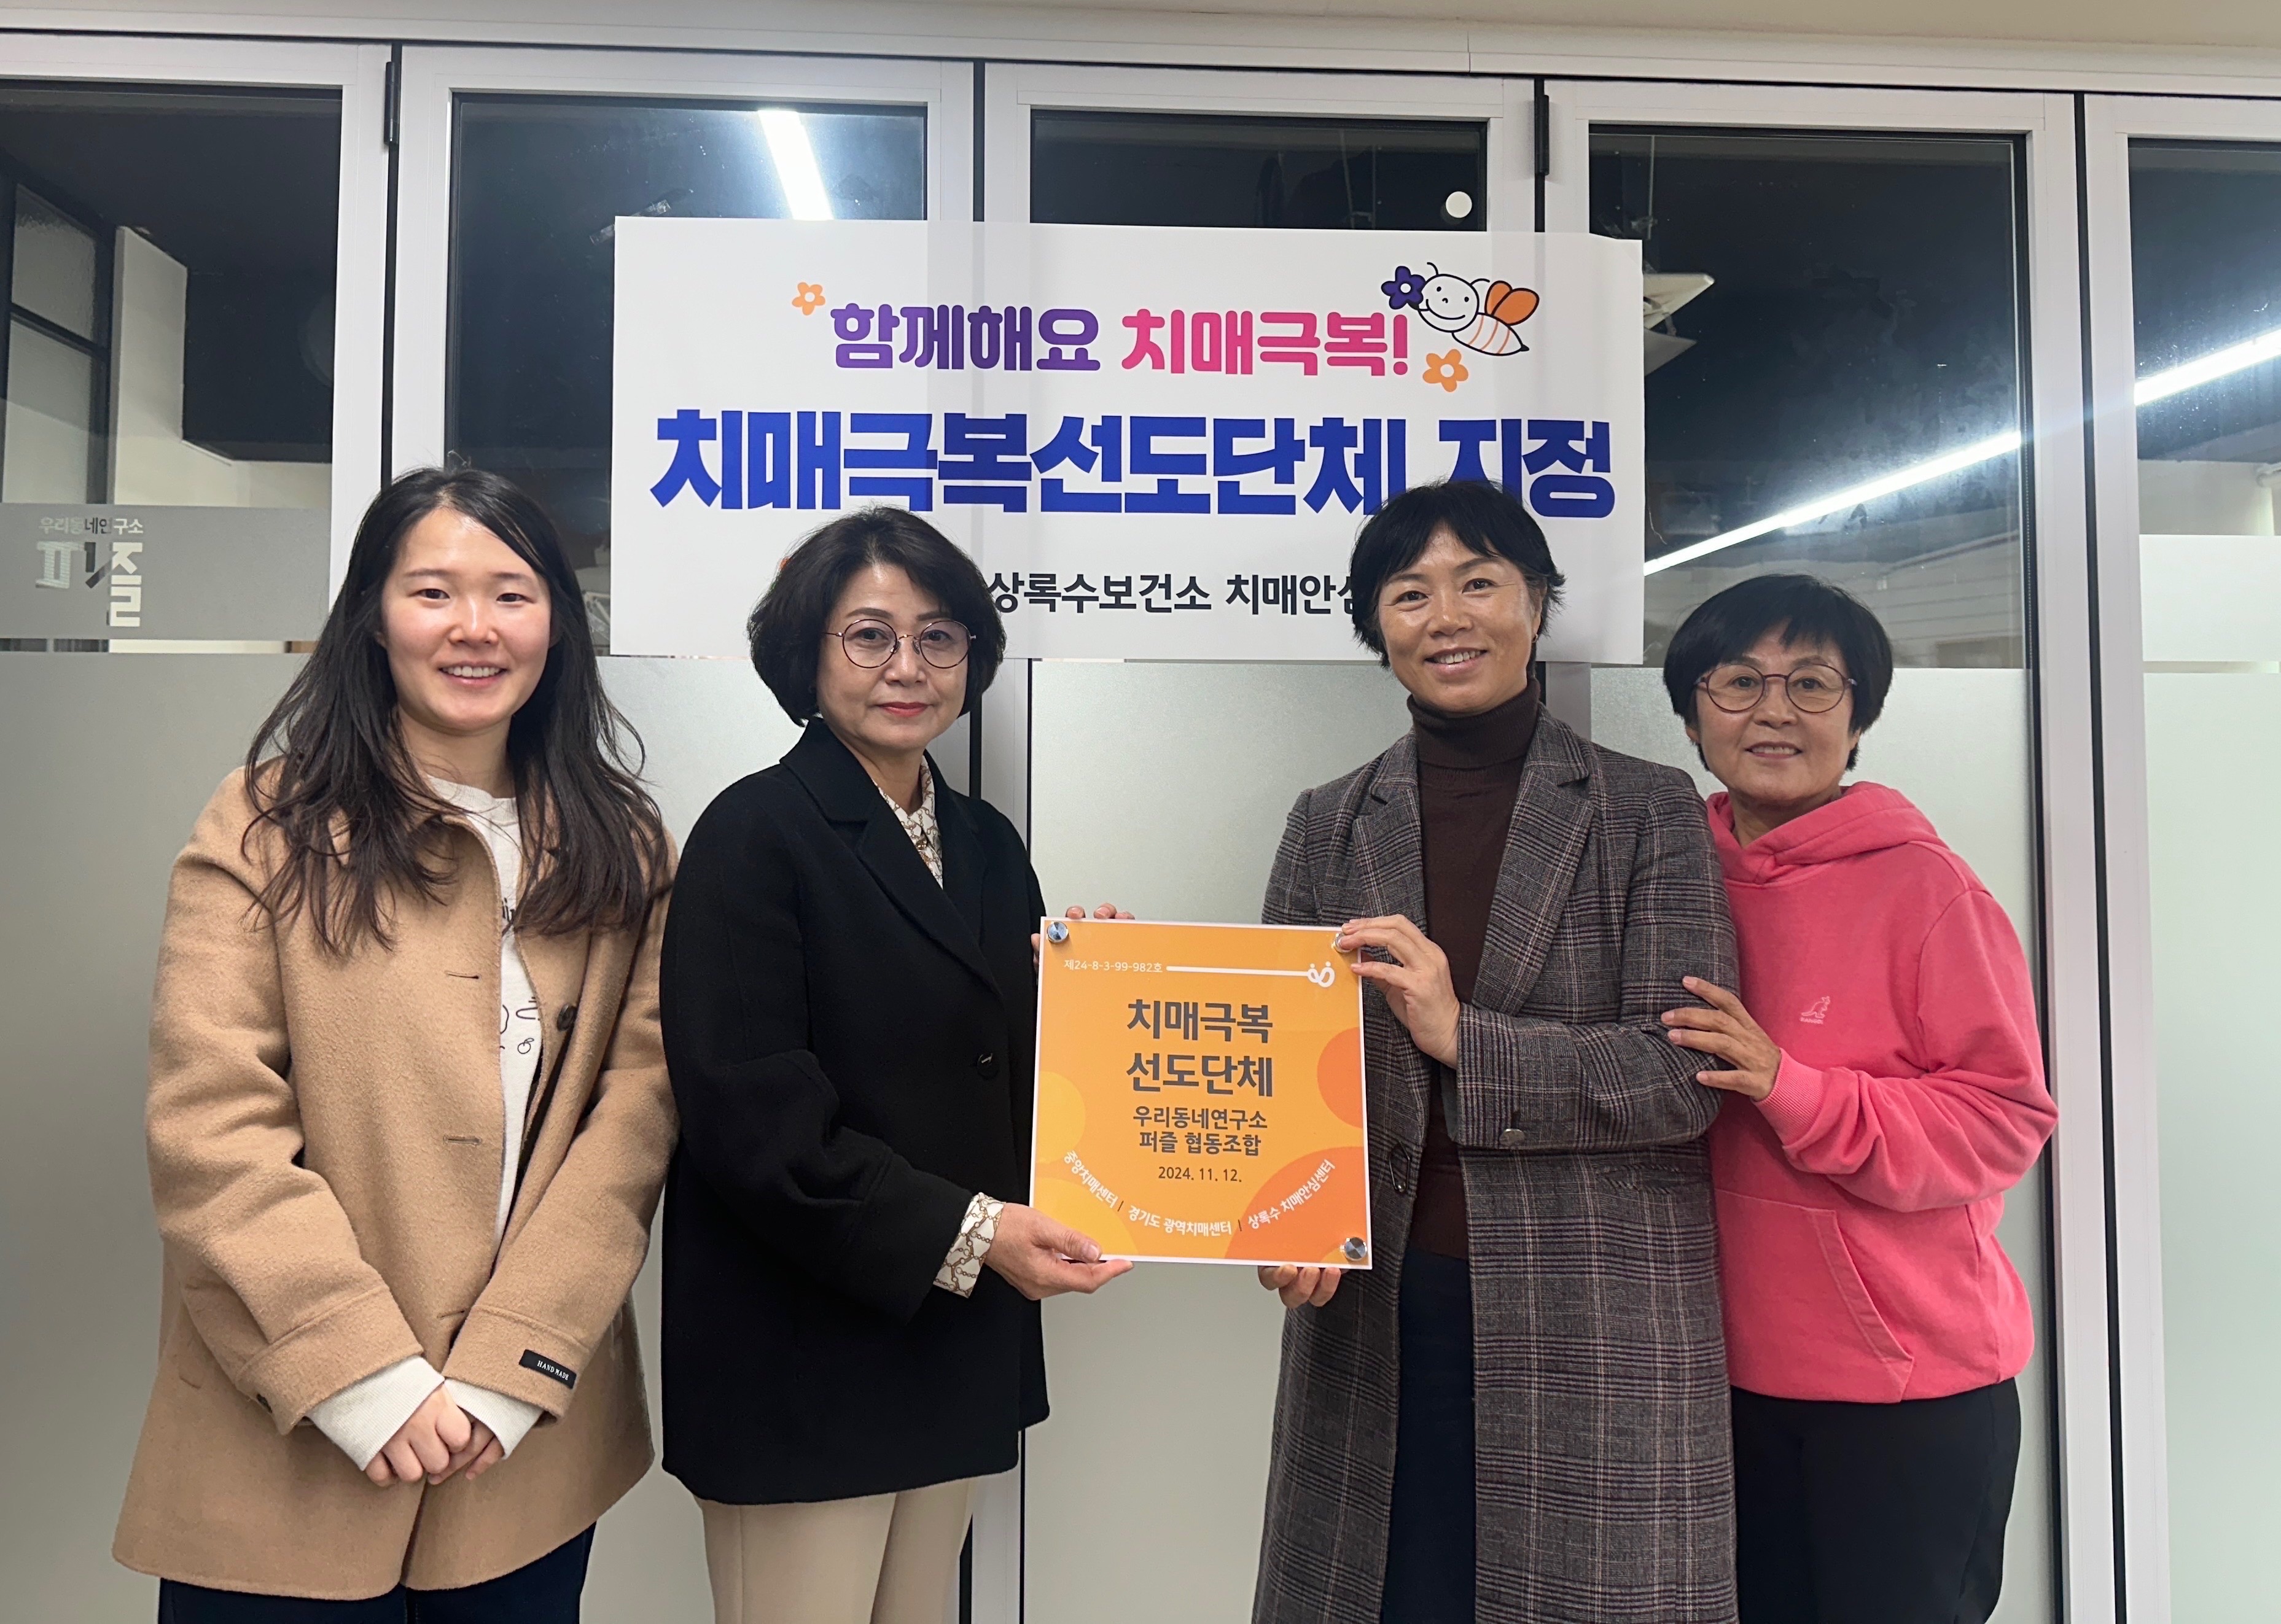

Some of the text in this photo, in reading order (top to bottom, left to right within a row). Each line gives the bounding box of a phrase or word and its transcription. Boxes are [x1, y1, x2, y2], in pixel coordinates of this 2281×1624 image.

[830, 303, 1409, 376] 함께해요 치매극복!
[650, 409, 1615, 518] 치매극복선도단체 지정
[988, 572, 1212, 614] 상록수보건소
[1064, 959, 1163, 973] 제24-8-3-99-982호
[1127, 999, 1273, 1043] 치매극복
[1126, 1052, 1273, 1097] 선도단체
[1133, 1106, 1268, 1131] 우리동네연구소
[1139, 1131, 1261, 1156] 퍼즐 협동조합
[1064, 1150, 1118, 1208] 중앙치매센터
[1158, 1167, 1242, 1183] 2024. 11. 12.
[1248, 1159, 1335, 1229] 상록수 치매안심센터
[1128, 1205, 1232, 1237] 경기도 광역치매센터
[537, 1360, 569, 1380] HAND MADE
